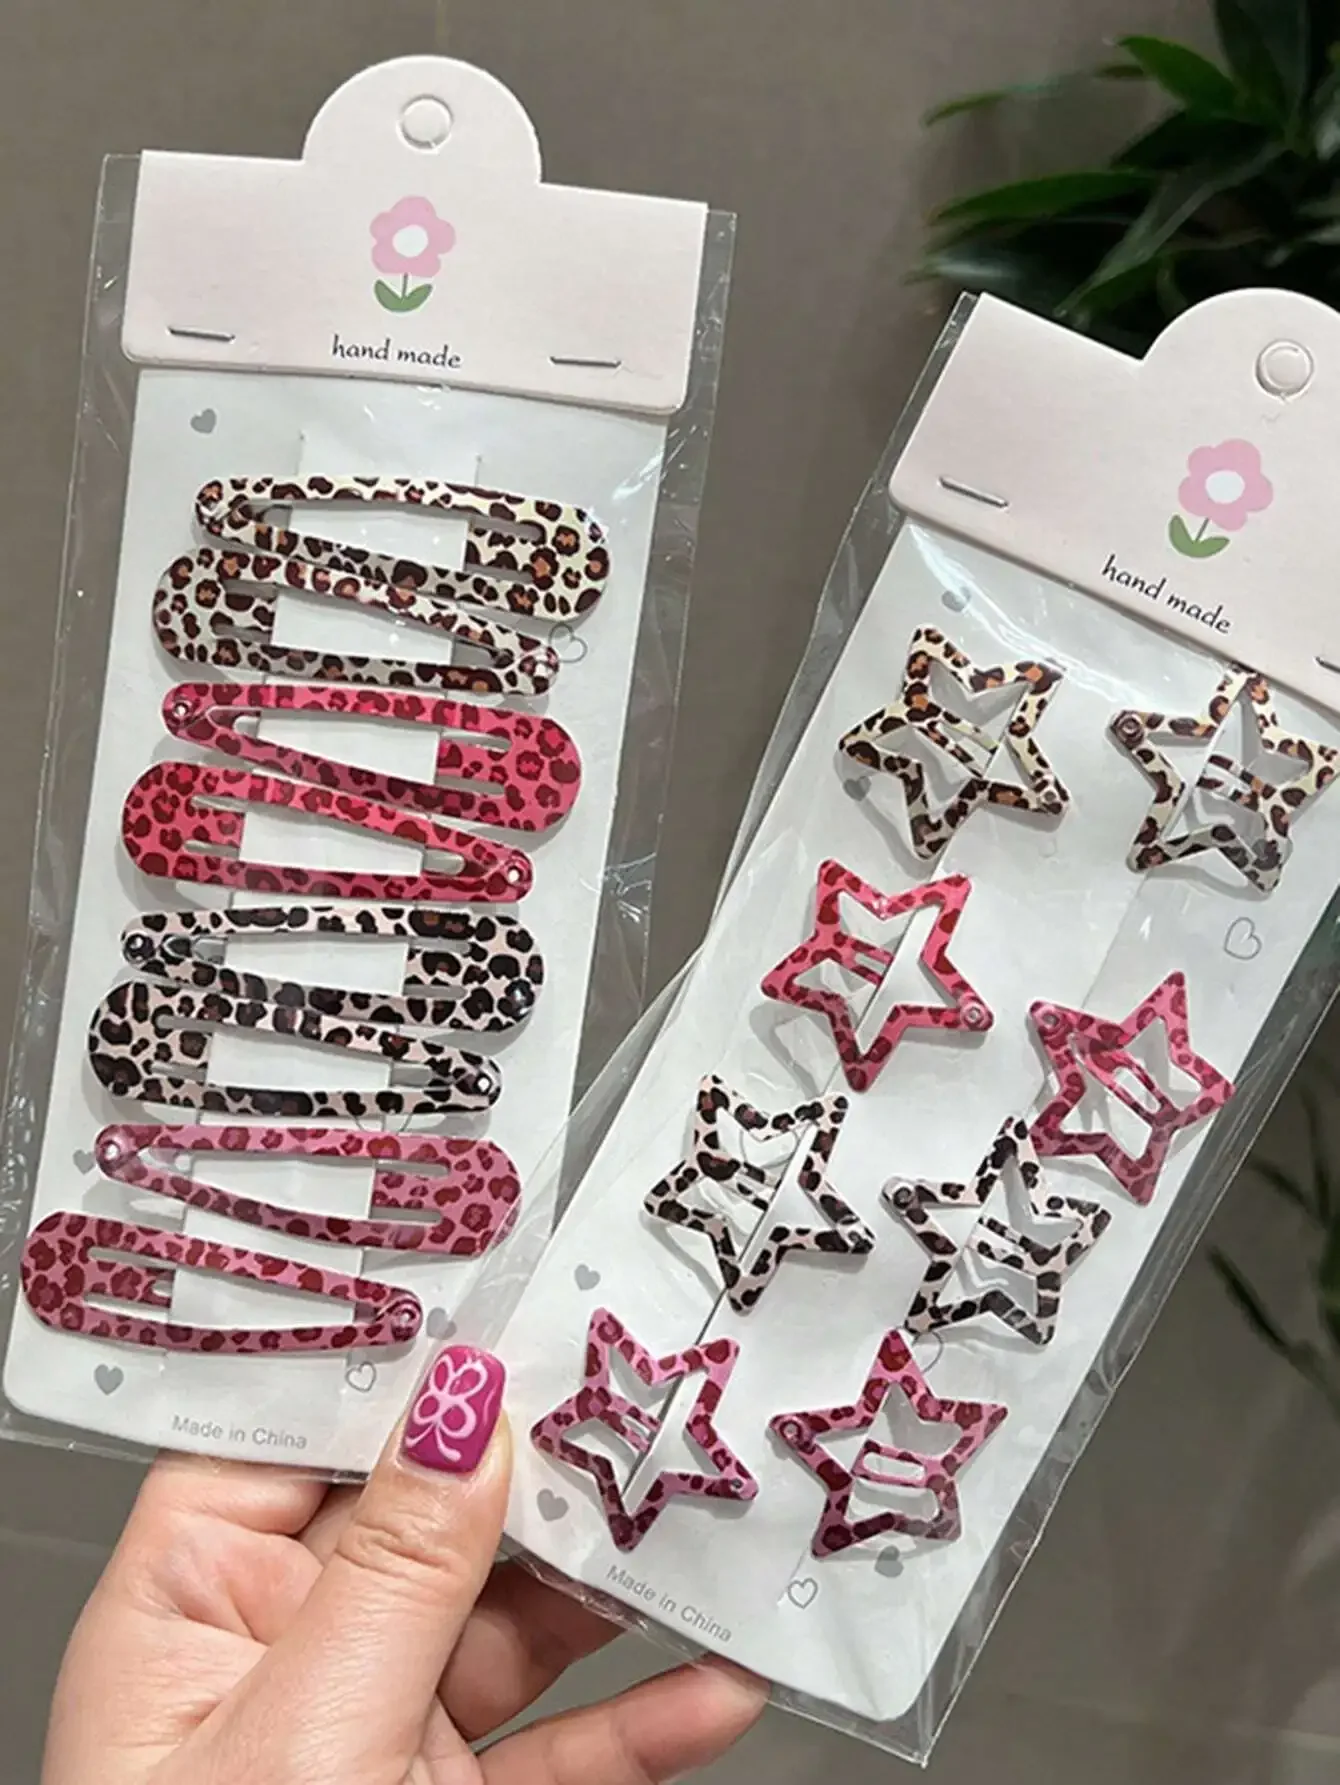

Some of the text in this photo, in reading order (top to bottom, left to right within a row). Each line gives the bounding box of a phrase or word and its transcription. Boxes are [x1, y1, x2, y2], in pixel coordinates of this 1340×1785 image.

[332, 333, 461, 368] hand made
[1101, 553, 1231, 634] hand made
[171, 1414, 307, 1449] Made in China
[606, 1564, 732, 1642] Made in China
